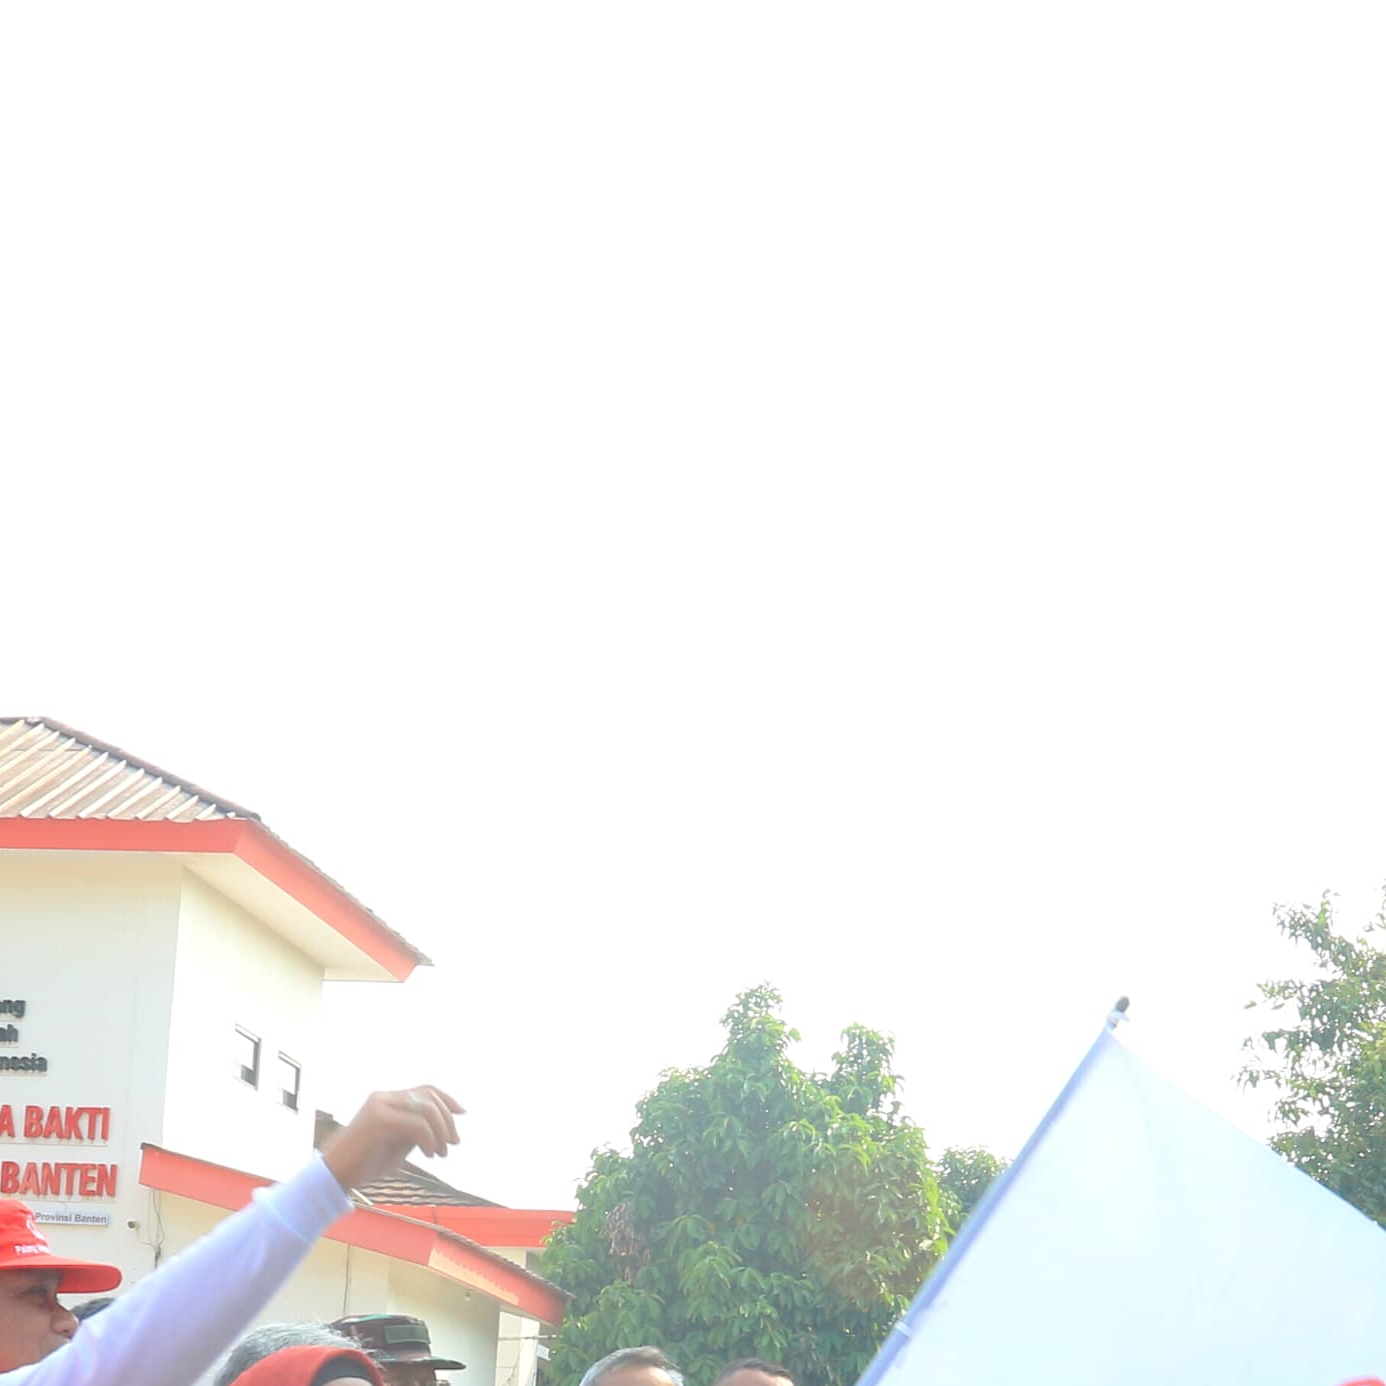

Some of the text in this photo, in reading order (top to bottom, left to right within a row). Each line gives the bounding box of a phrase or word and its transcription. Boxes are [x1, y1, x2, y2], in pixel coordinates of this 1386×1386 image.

[23, 1105, 110, 1141] BAKTI
[0, 1161, 118, 1197] BANTEN
[35, 1212, 72, 1222] Provinsi
[74, 1213, 107, 1223] Banten
